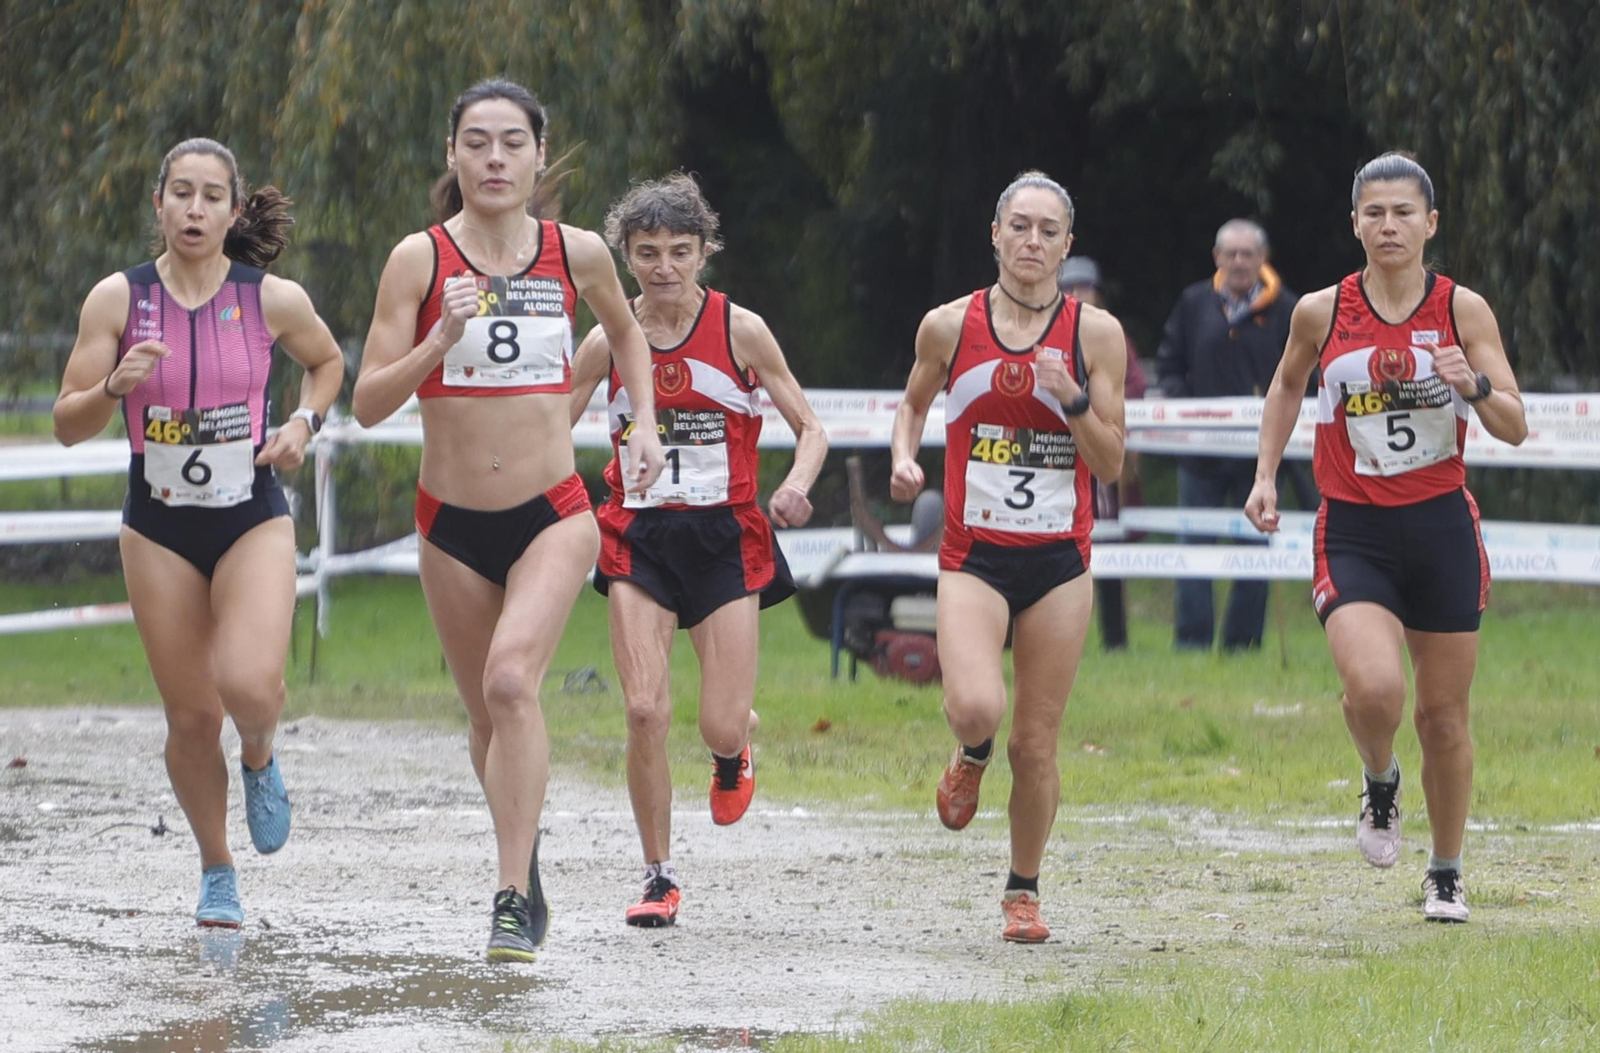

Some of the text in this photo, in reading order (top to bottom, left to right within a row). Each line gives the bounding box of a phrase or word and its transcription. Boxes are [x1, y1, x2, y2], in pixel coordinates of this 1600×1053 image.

[510, 279, 563, 290] MEMORIAL
[506, 291, 564, 302] BELARMINO
[523, 301, 563, 312] ALONSO
[486, 319, 521, 364] 8
[1402, 376, 1441, 391] MEMORI
[1415, 391, 1450, 407] ALONSO
[203, 404, 249, 421] MEMORIAL
[677, 411, 726, 421] MEMORIAL
[199, 414, 250, 432] BELARMINO
[673, 420, 726, 431] BELARMINO
[214, 425, 250, 440] ALONSO
[689, 429, 724, 440] ALONSO
[1386, 412, 1416, 452] 5
[1029, 443, 1076, 455] BELARMINO
[181, 448, 212, 486] 6
[665, 448, 680, 485] 1
[1042, 454, 1074, 466] ALONSO
[1003, 469, 1036, 510] 3
